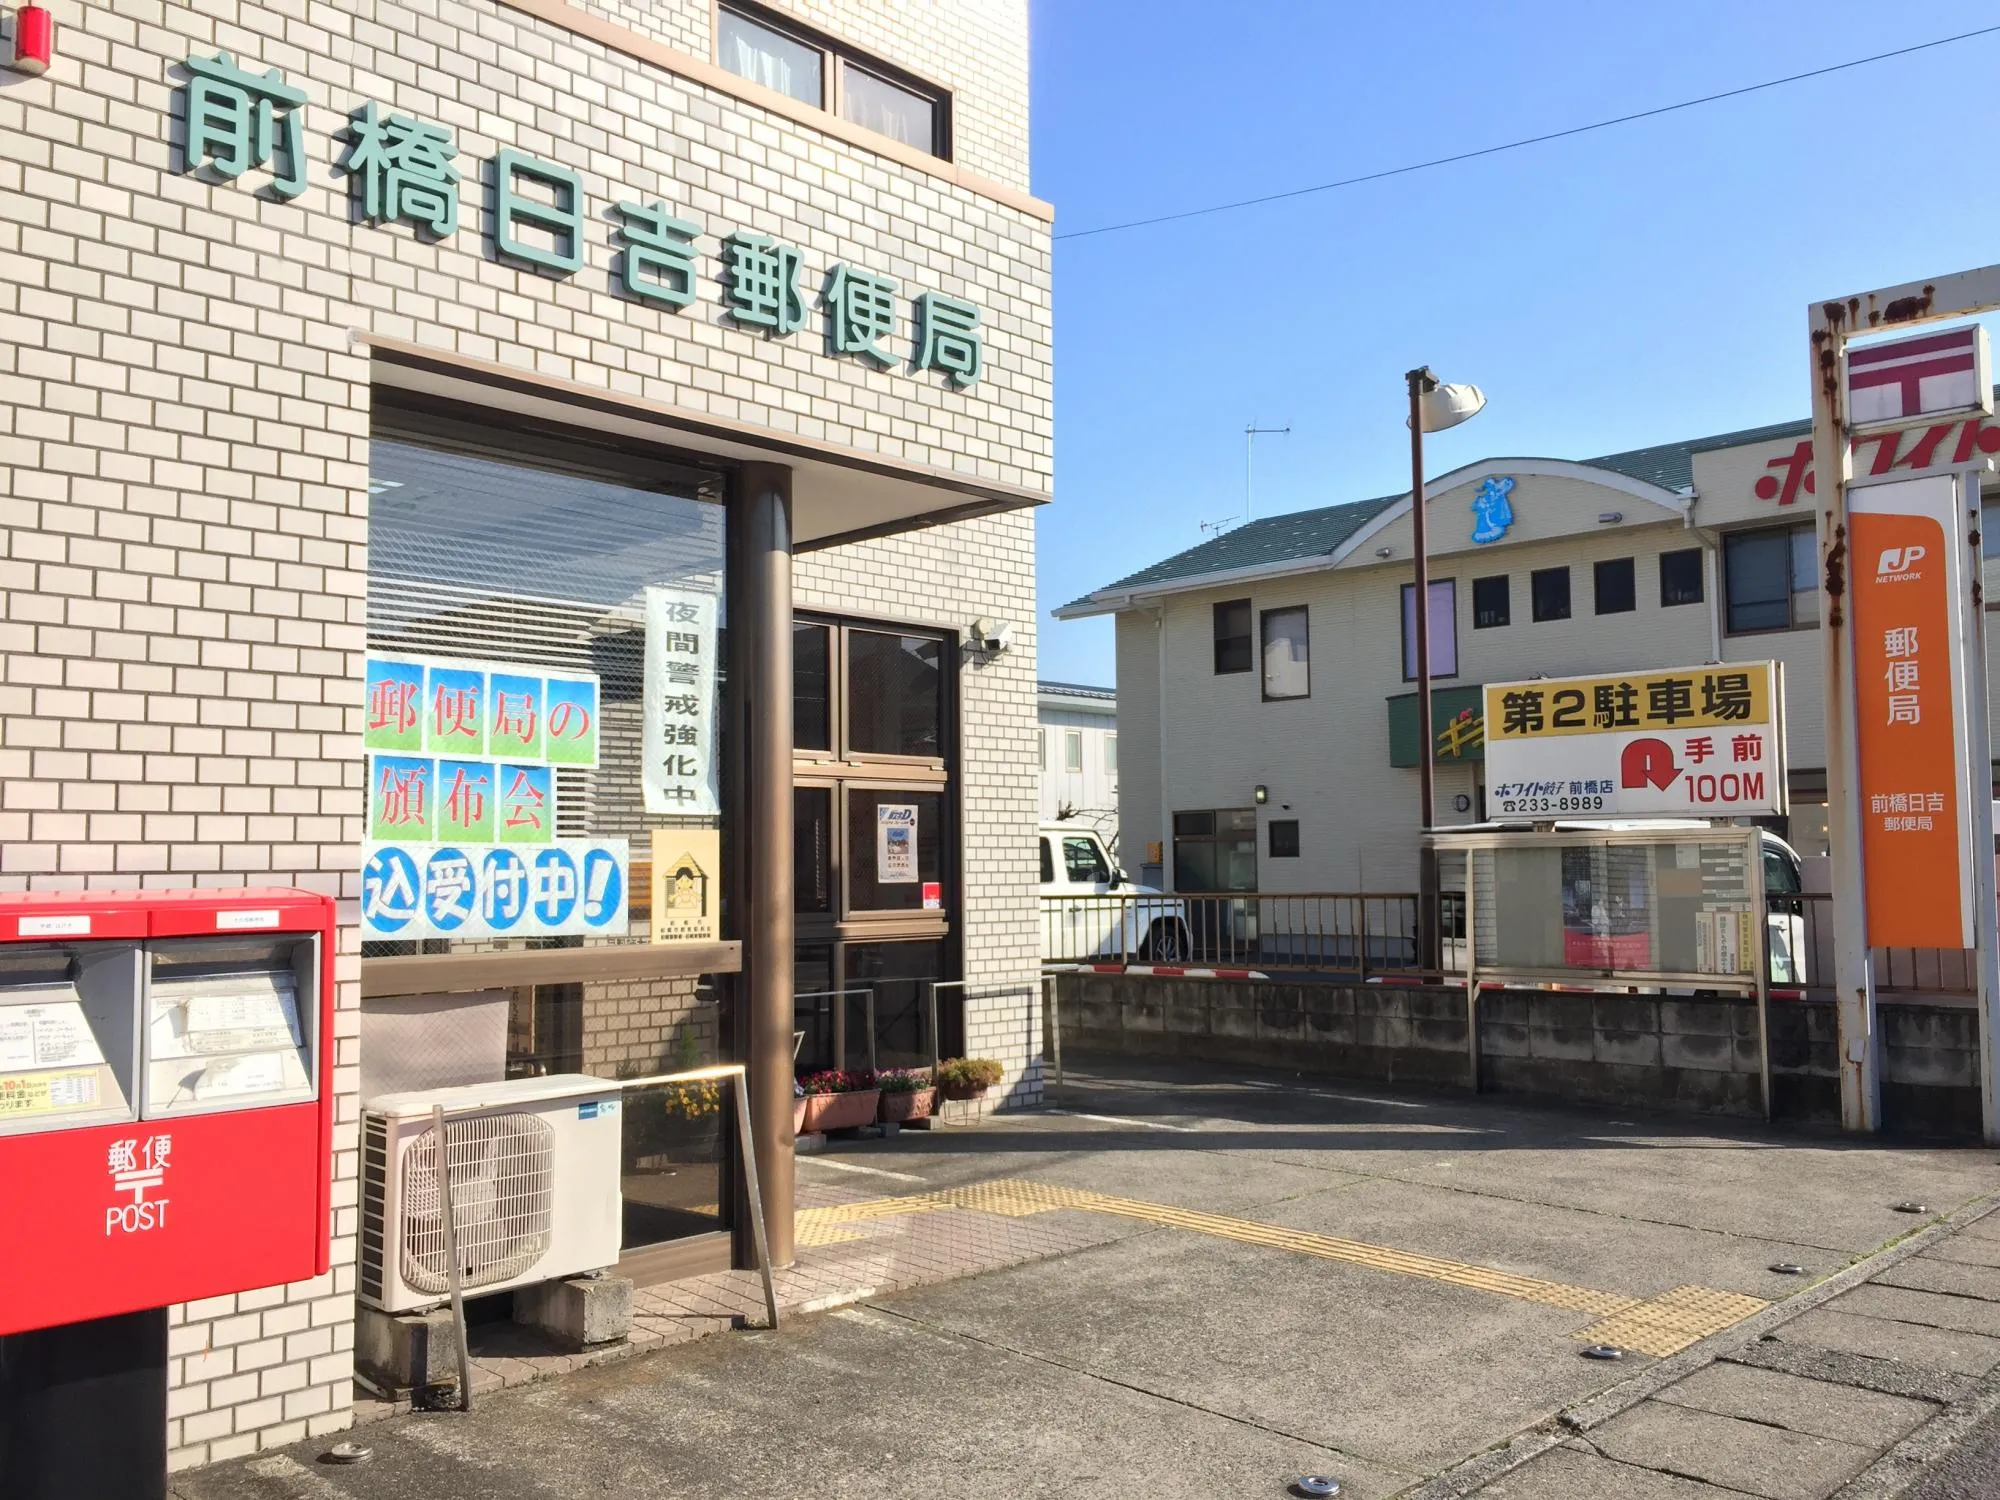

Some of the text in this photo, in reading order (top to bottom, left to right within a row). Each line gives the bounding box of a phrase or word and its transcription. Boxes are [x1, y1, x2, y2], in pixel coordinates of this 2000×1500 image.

[185, 53, 984, 386] 前橋日吉郵便局
[1875, 571, 1922, 584] NETWORK
[1884, 627, 1921, 727] 郵便局
[368, 679, 591, 744] 郵便局の
[662, 601, 700, 807] 夜間警戒強化中
[1502, 673, 1753, 735] 第2駐車場
[1685, 734, 1763, 764] 手前
[380, 765, 545, 829] 頒布会
[1518, 796, 1603, 812] 233-8989
[1569, 779, 1614, 795] 前橋店
[1685, 772, 1764, 803] 100M
[1871, 793, 1945, 813] 前橋日吉
[1884, 816, 1933, 832] 郵便局
[107, 1134, 172, 1174] 郵便
[106, 1199, 170, 1237] POST
